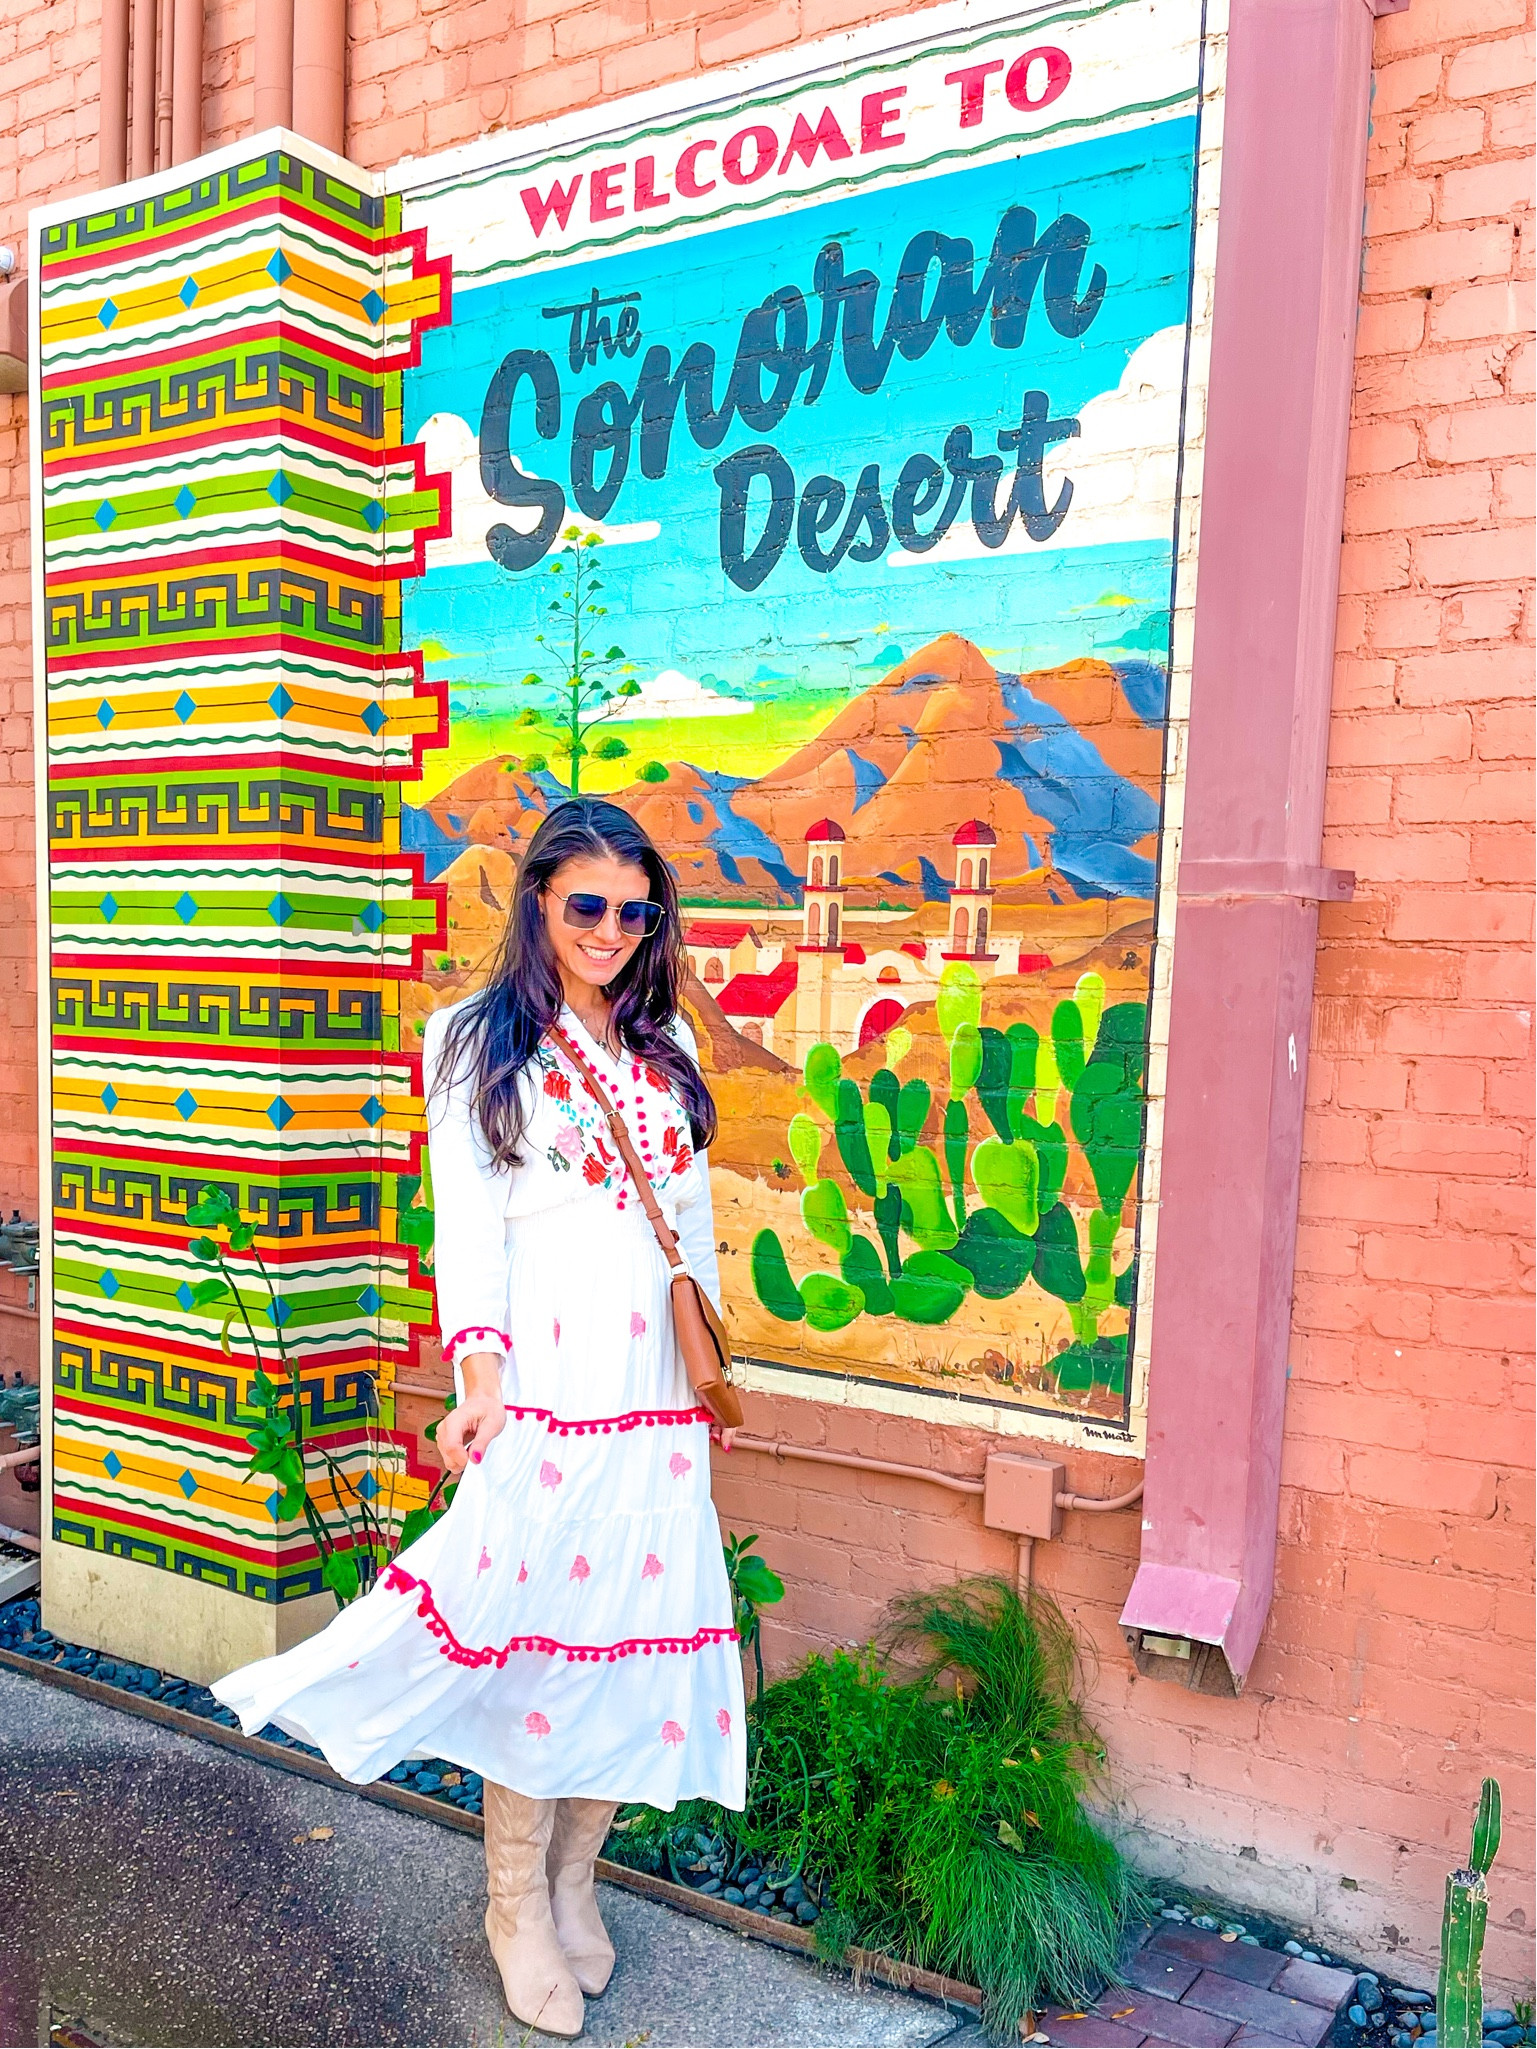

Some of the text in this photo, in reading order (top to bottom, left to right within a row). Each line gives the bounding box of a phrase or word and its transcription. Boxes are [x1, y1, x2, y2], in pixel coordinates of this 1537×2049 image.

[520, 45, 1072, 239] WELCOME TO
[479, 205, 1109, 572] Sonoran
[541, 287, 643, 375] The
[714, 390, 1082, 592] Desert
